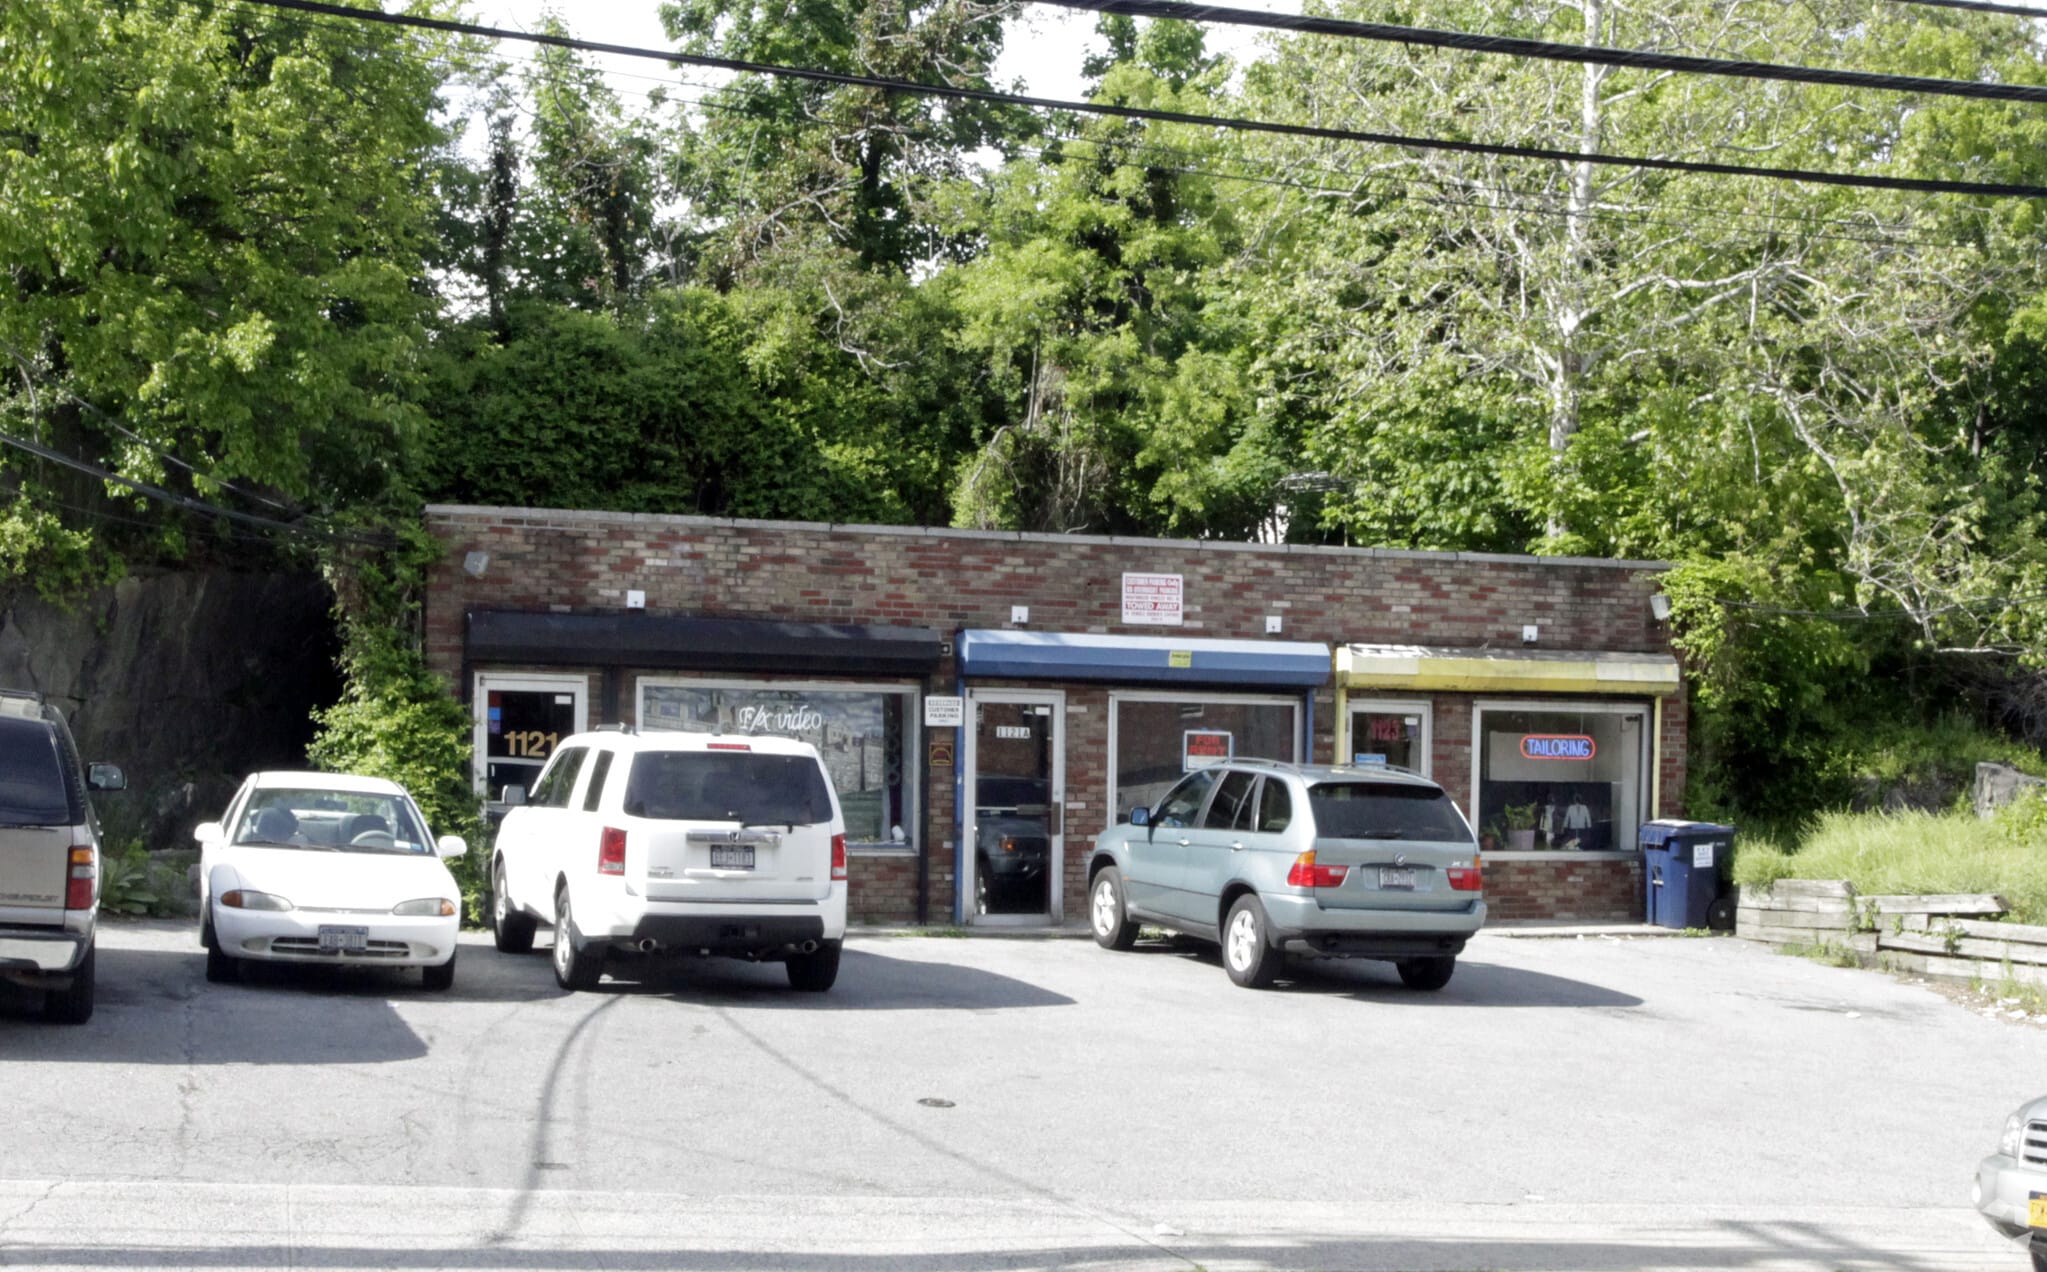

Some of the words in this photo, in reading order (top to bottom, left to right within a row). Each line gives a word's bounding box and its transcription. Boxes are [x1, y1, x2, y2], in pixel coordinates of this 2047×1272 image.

[1126, 601, 1154, 610] TOWED
[1156, 602, 1179, 611] AWAY
[774, 704, 822, 730] video
[998, 727, 1029, 737] 1121A
[503, 730, 559, 757] 1121
[1195, 735, 1220, 745] FOR
[1188, 745, 1225, 757] RENT
[1527, 738, 1590, 757] TAILORING
